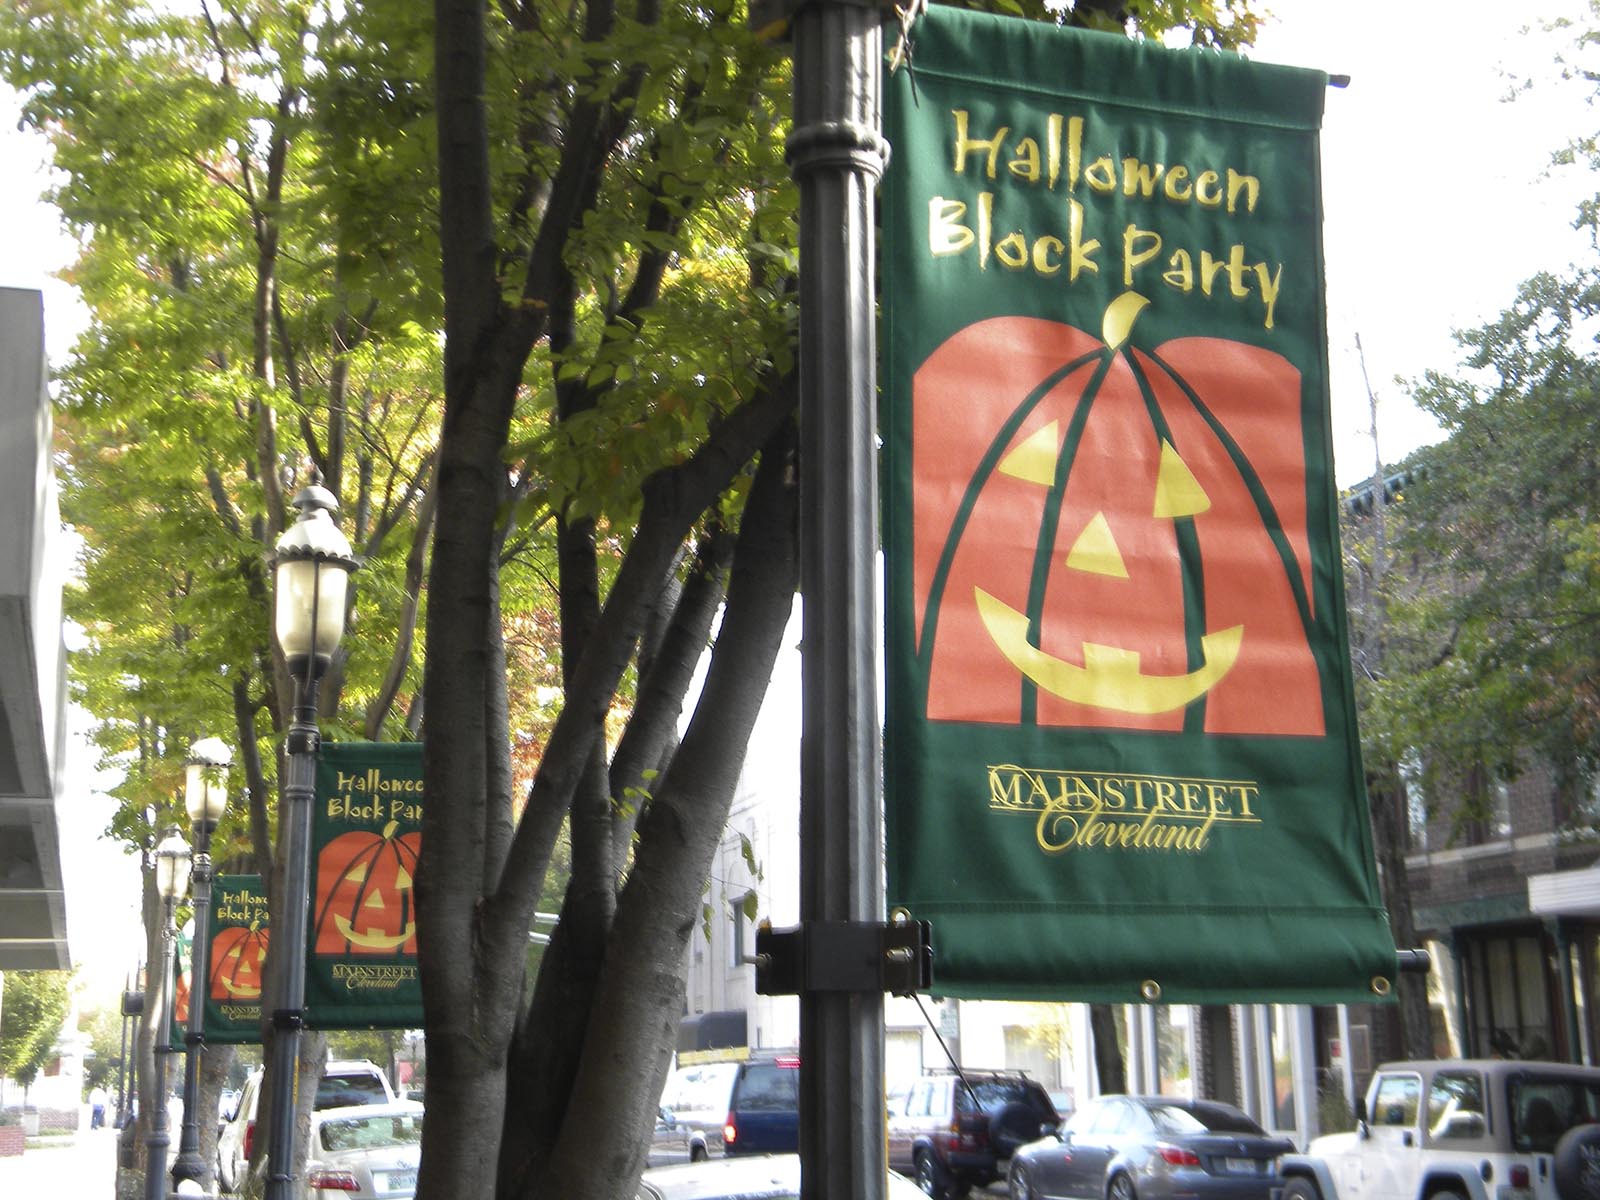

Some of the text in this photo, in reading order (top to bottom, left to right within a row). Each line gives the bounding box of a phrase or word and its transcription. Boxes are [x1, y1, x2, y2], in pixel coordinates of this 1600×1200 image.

[952, 109, 1260, 213] Halloween
[929, 191, 1282, 329] Block Party
[337, 768, 424, 792] Hallowee
[988, 767, 1261, 818] MAINSTREET
[328, 794, 423, 819] Block Par
[1036, 794, 1216, 851] Cleveland
[217, 905, 251, 920] Block
[331, 965, 417, 979] MAINSTREET
